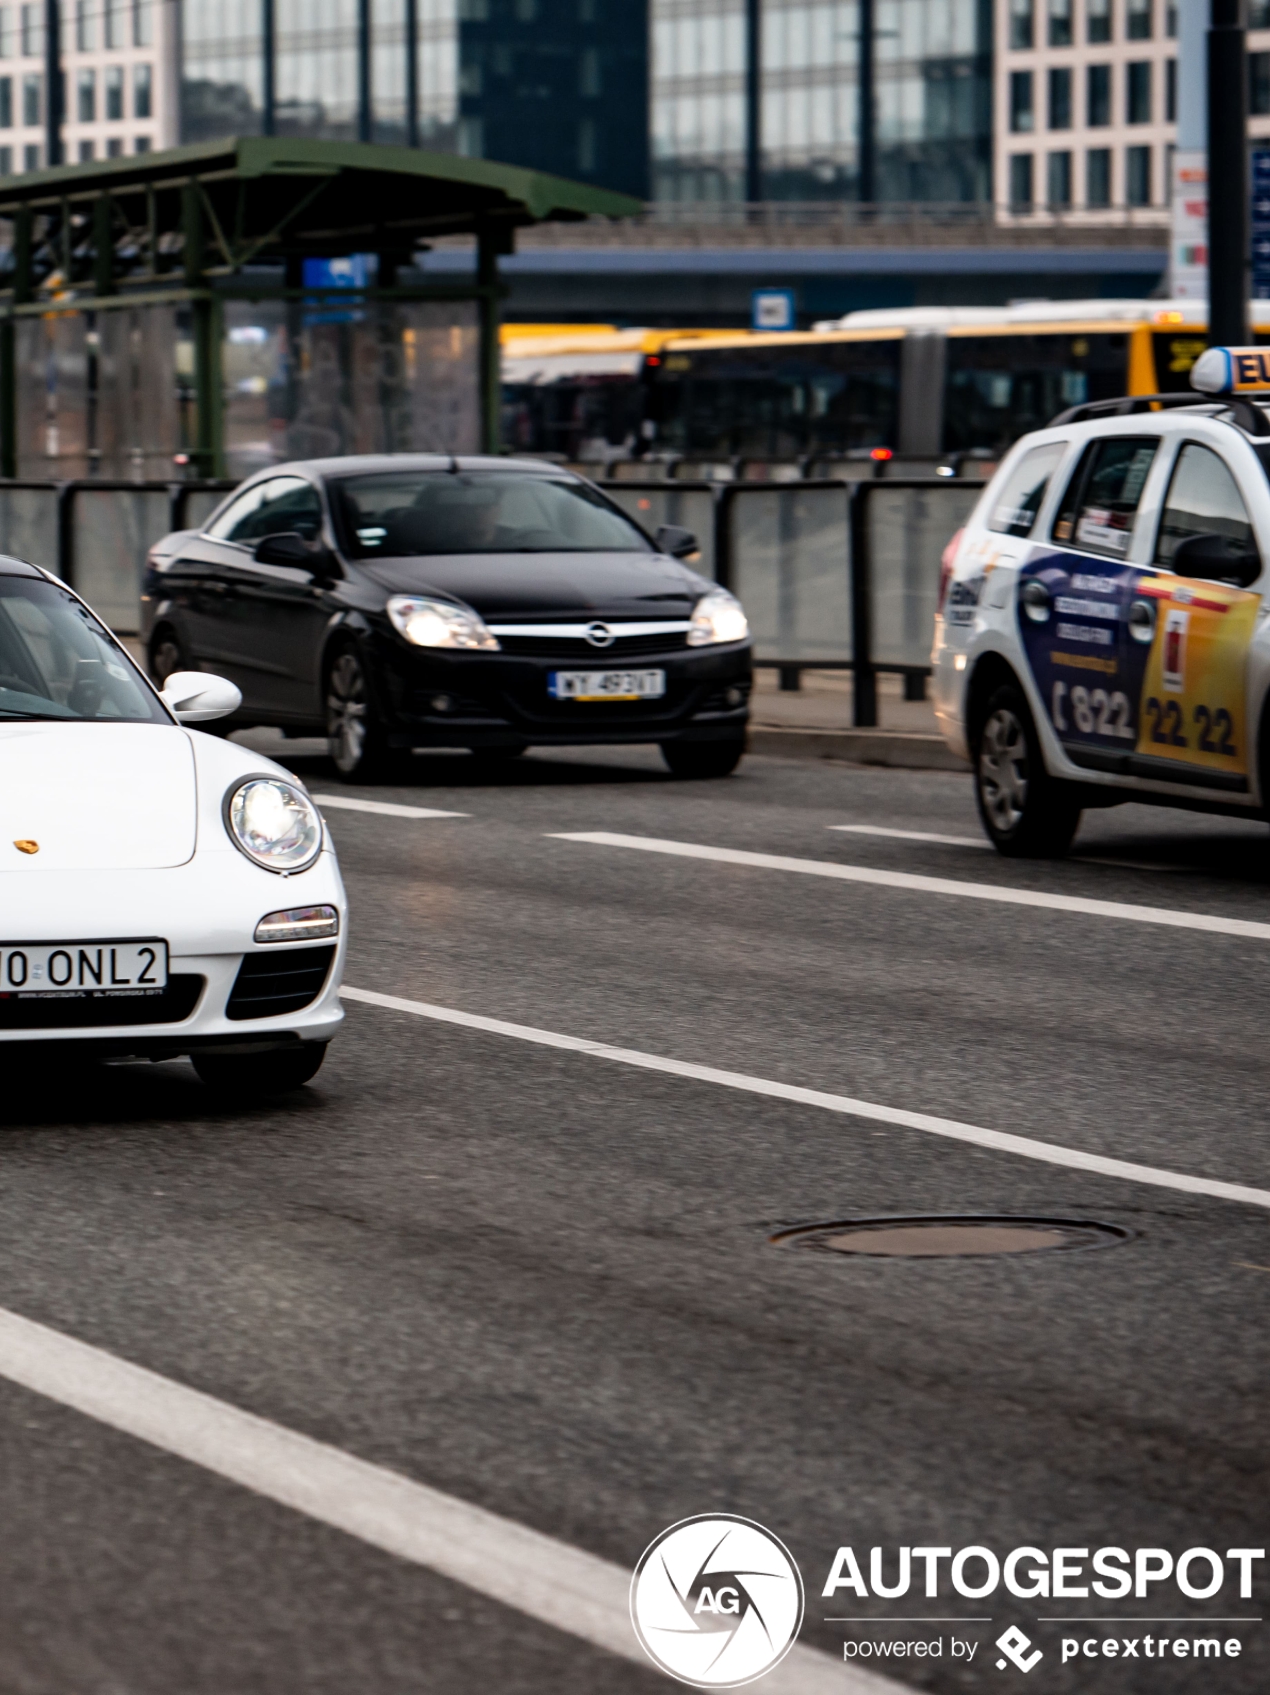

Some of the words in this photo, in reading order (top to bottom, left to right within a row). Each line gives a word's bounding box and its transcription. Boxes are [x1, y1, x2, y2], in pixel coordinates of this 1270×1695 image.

[1071, 685, 1135, 739] 822
[1146, 697, 1187, 748] 22
[1194, 704, 1236, 756] 22
[48, 947, 156, 986] ONL2
